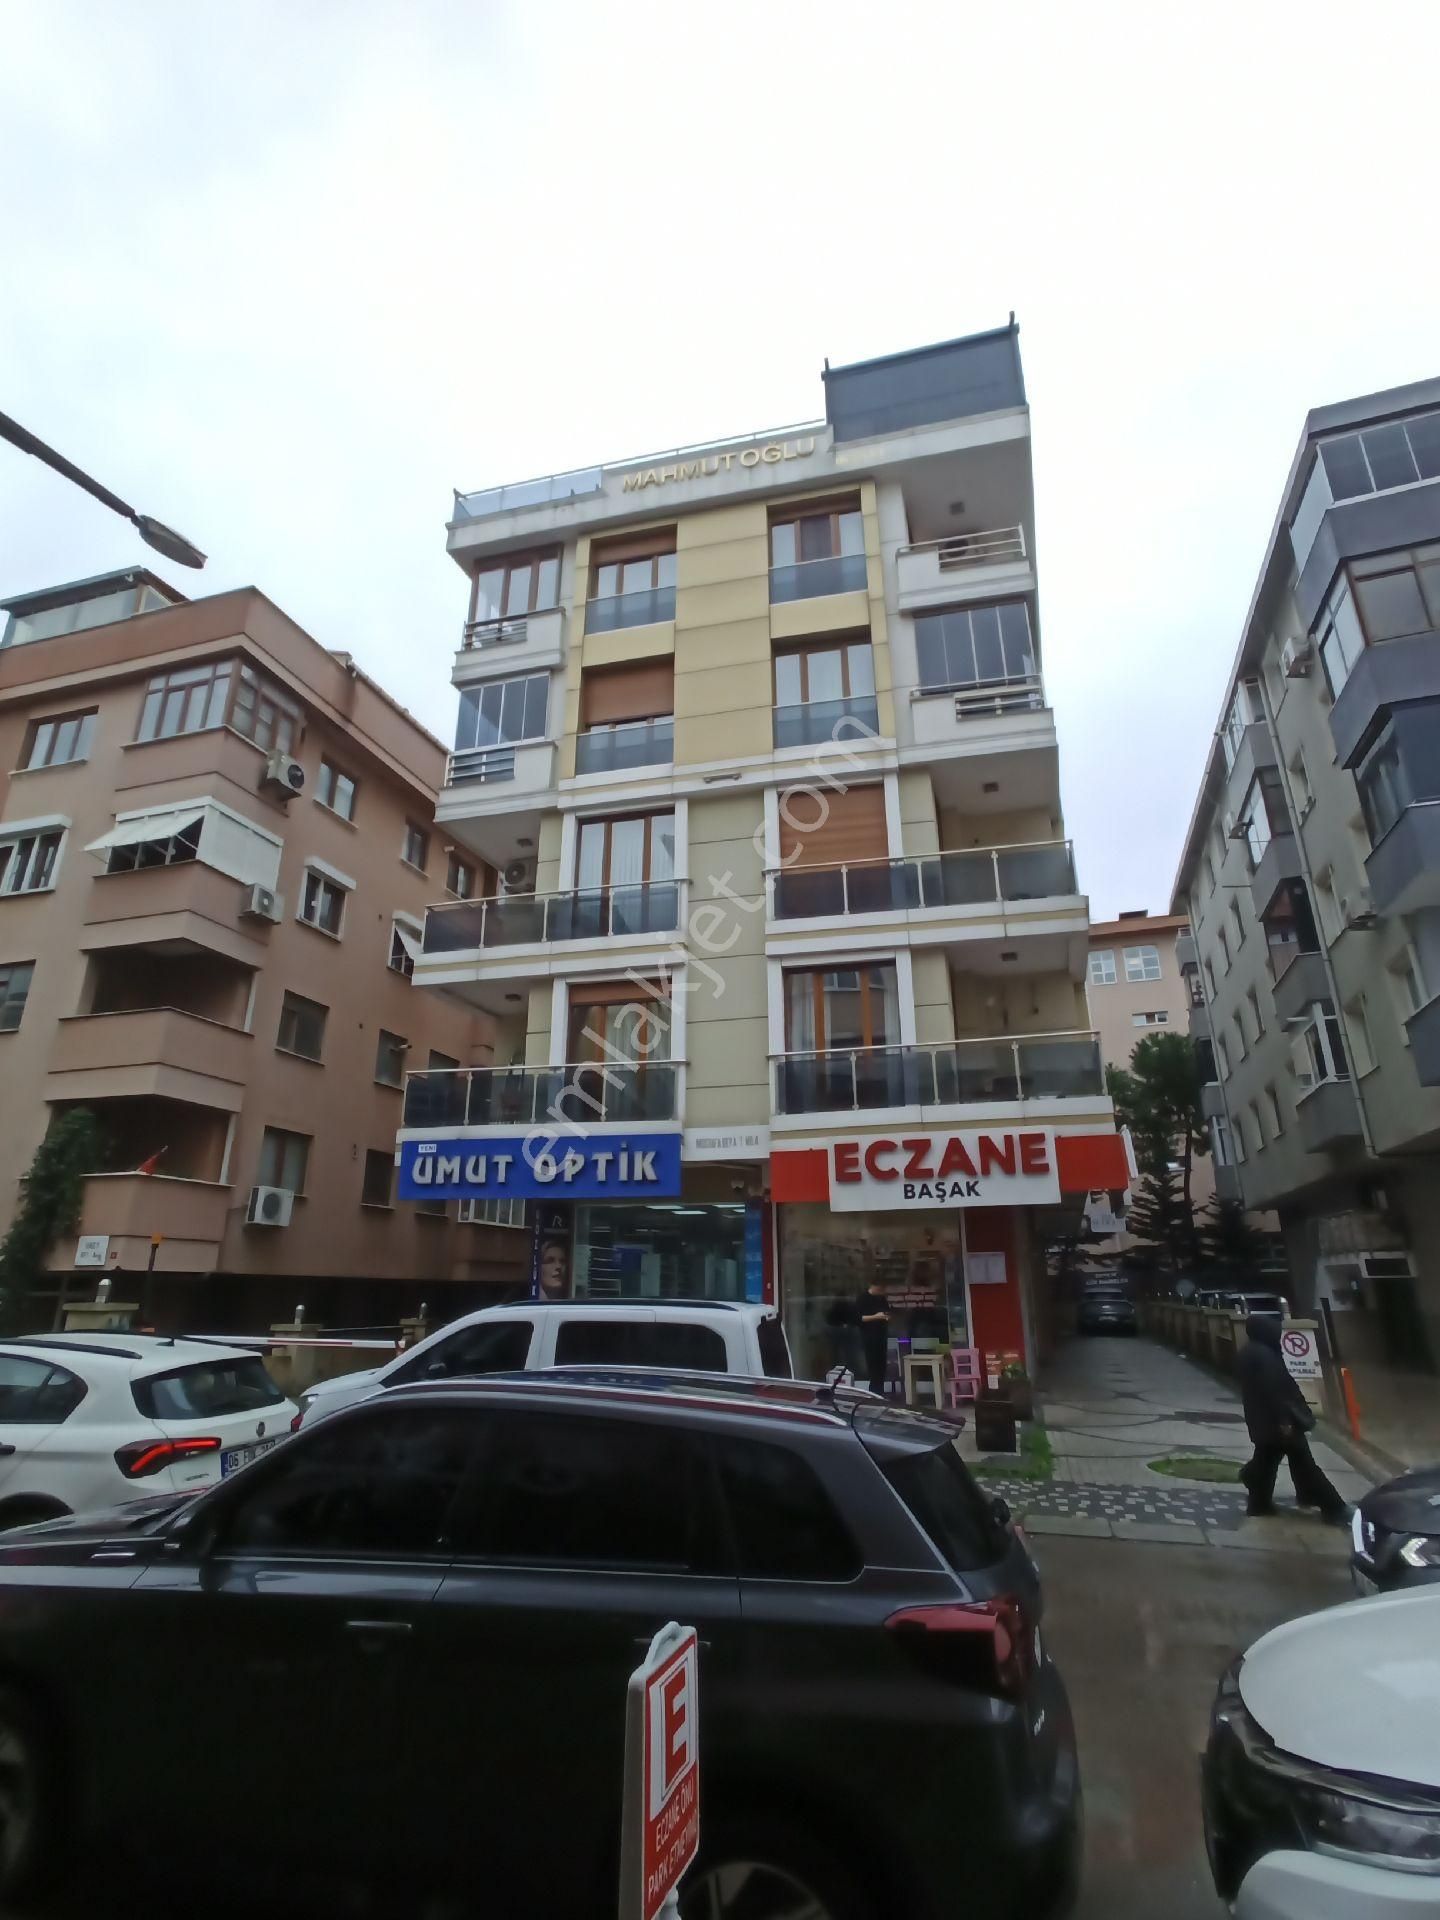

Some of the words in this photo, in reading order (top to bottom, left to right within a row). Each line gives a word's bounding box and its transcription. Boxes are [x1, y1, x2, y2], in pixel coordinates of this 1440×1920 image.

[533, 1141, 659, 1183] OPTİK
[833, 1133, 1051, 1183] ECZANE
[903, 1180, 982, 1203] BAŞAK
[663, 1665, 689, 1789] E
[655, 1793, 680, 1853] ECZANE
[647, 1855, 670, 1904] PARK
